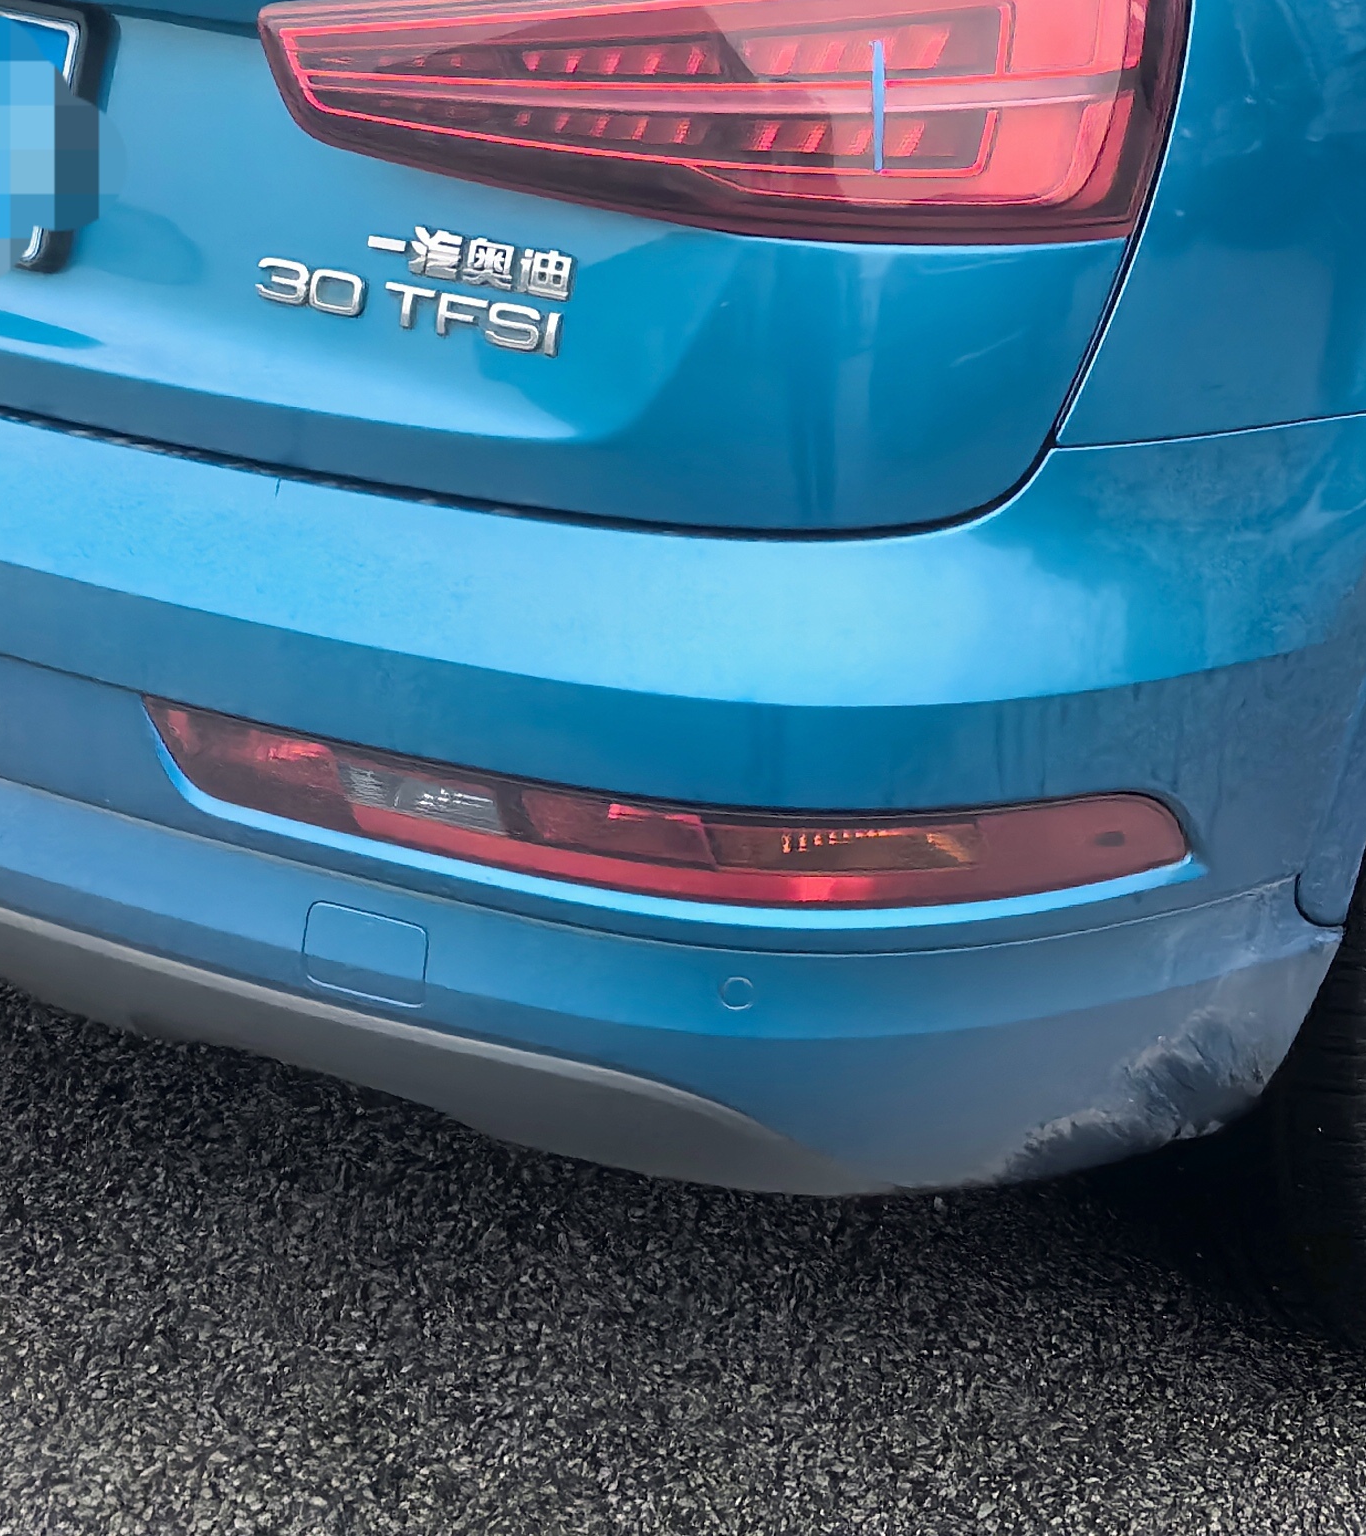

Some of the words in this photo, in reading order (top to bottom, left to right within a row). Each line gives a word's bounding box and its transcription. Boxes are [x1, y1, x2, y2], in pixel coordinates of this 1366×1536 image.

[367, 225, 576, 301] 一汽奥迪
[255, 257, 368, 318] 30
[385, 281, 565, 358] TFSI
